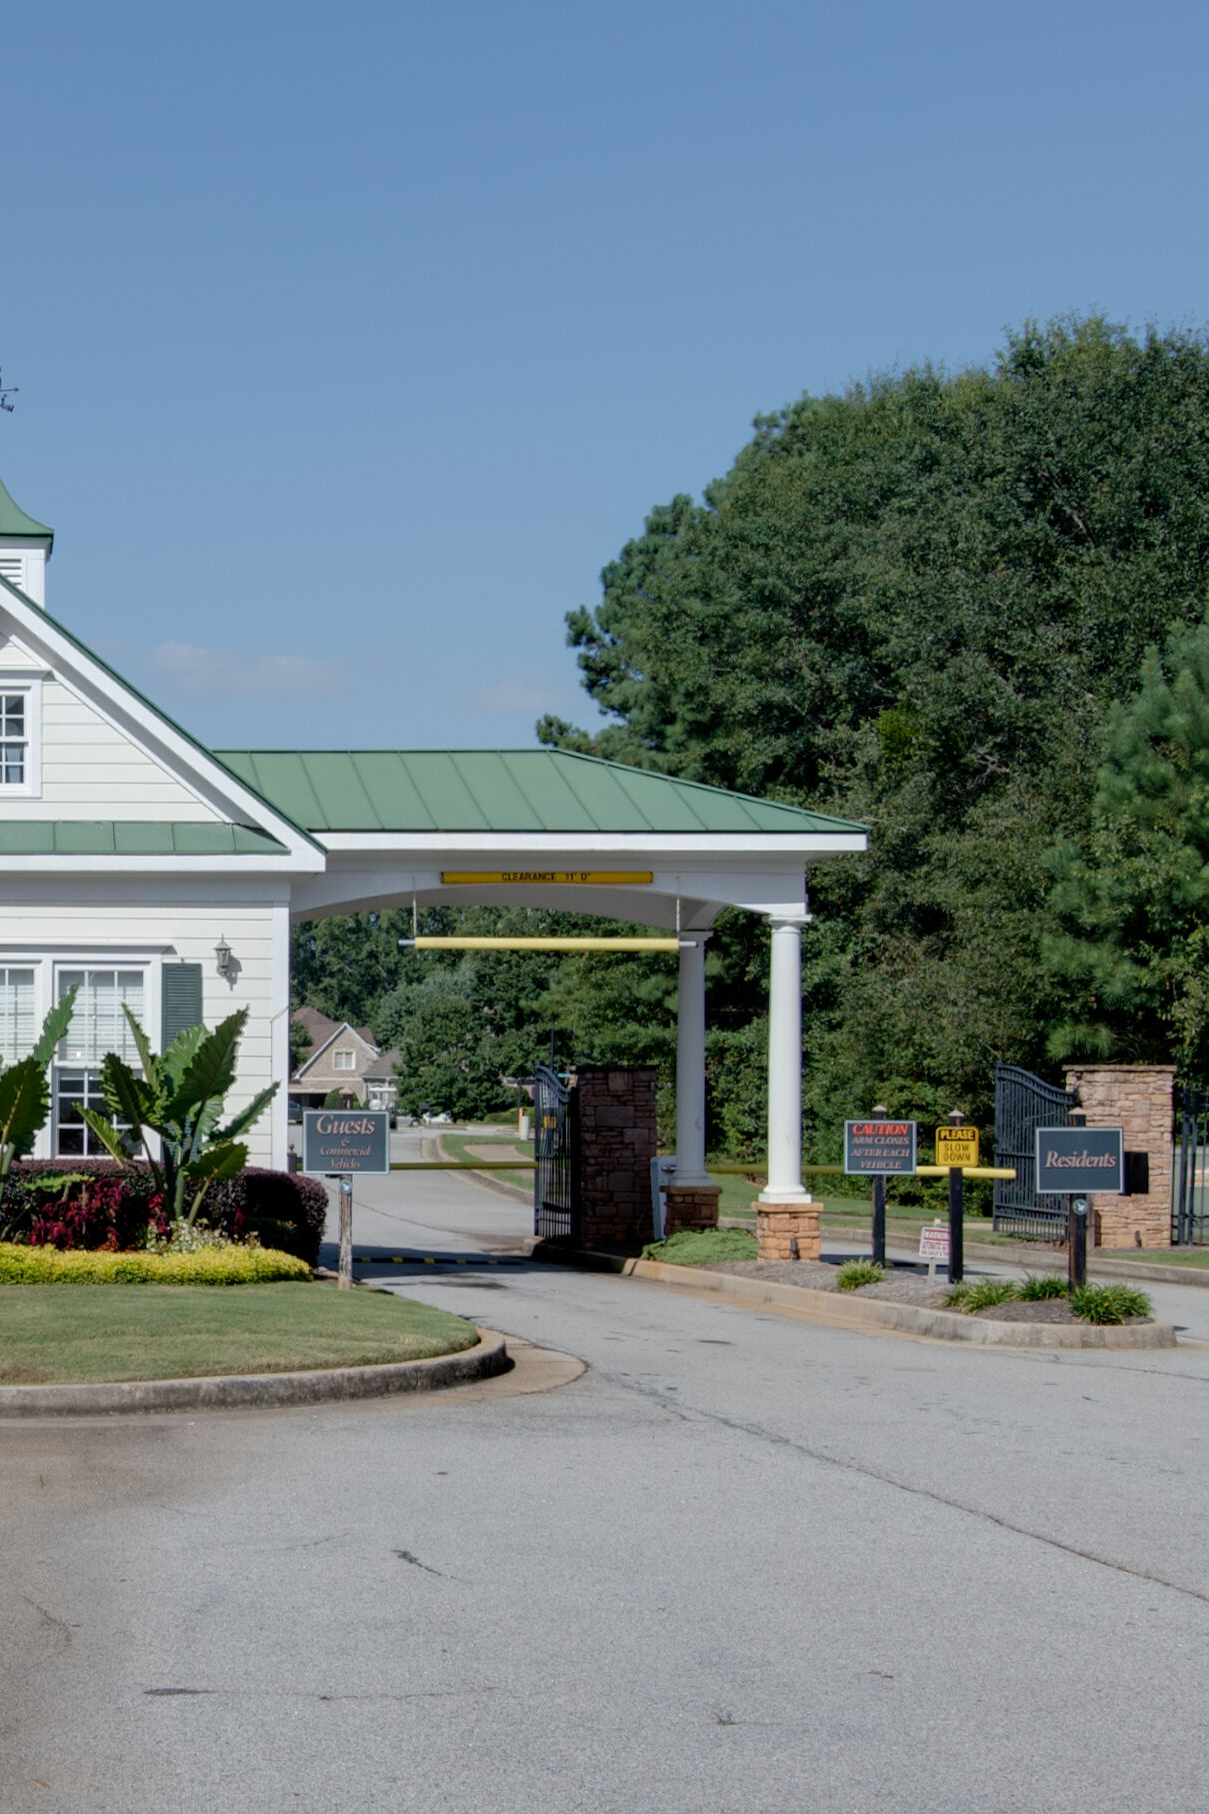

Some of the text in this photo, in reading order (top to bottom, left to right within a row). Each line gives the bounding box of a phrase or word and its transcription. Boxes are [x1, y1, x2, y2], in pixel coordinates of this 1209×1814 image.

[501, 871, 557, 881] CLEARANCE
[316, 1114, 376, 1135] Guests
[852, 1123, 910, 1136] CAUTION
[940, 1129, 974, 1140] PLEASE
[341, 1137, 350, 1147] &
[852, 1136, 910, 1145] ARM CLOSES
[320, 1146, 372, 1157] Commercial
[943, 1142, 970, 1152] SLOW
[943, 1152, 971, 1162] DOWN
[1045, 1149, 1117, 1168] Residents
[330, 1158, 362, 1169] Vehicles
[860, 1160, 902, 1170] VEHICLE
